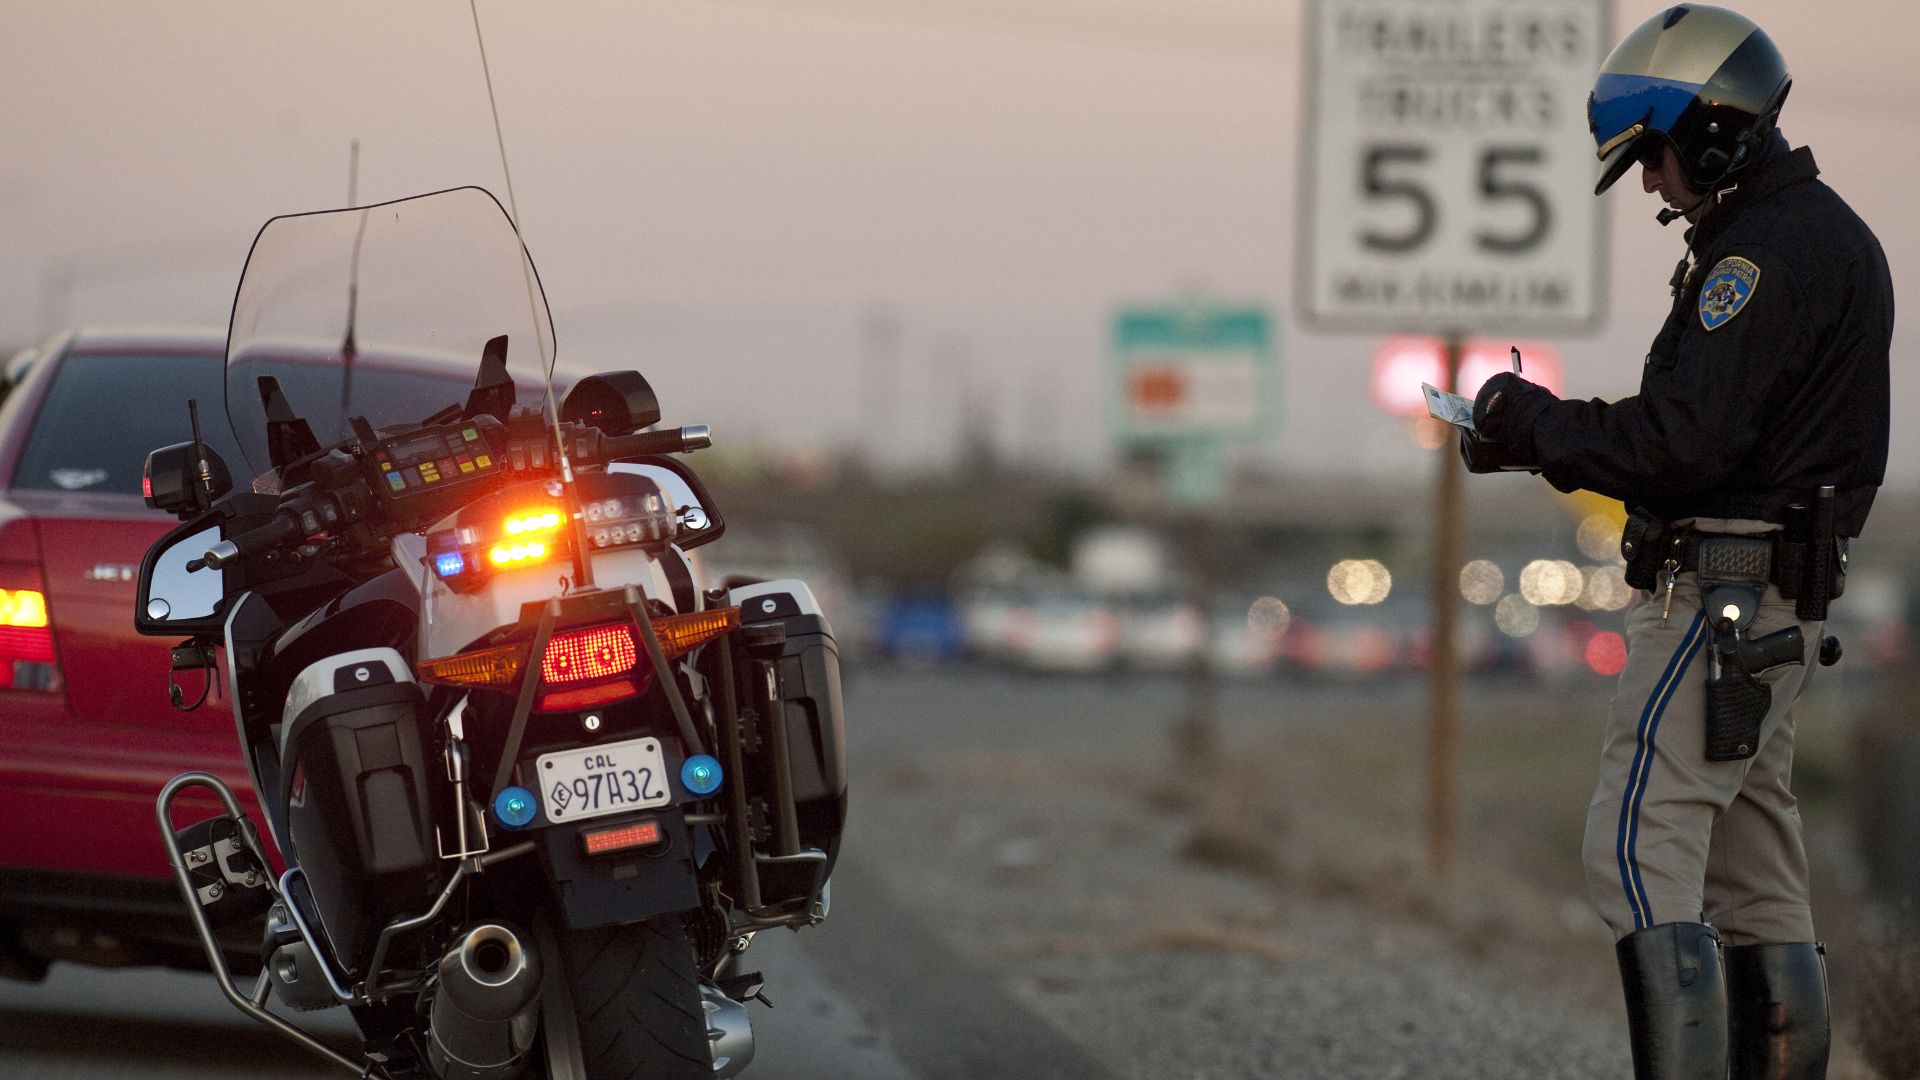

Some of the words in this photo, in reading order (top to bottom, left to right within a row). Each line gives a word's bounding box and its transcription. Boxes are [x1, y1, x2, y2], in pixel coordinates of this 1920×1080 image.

[1357, 143, 1552, 256] 55
[584, 754, 616, 770] CAL
[573, 767, 657, 811] 97A32
